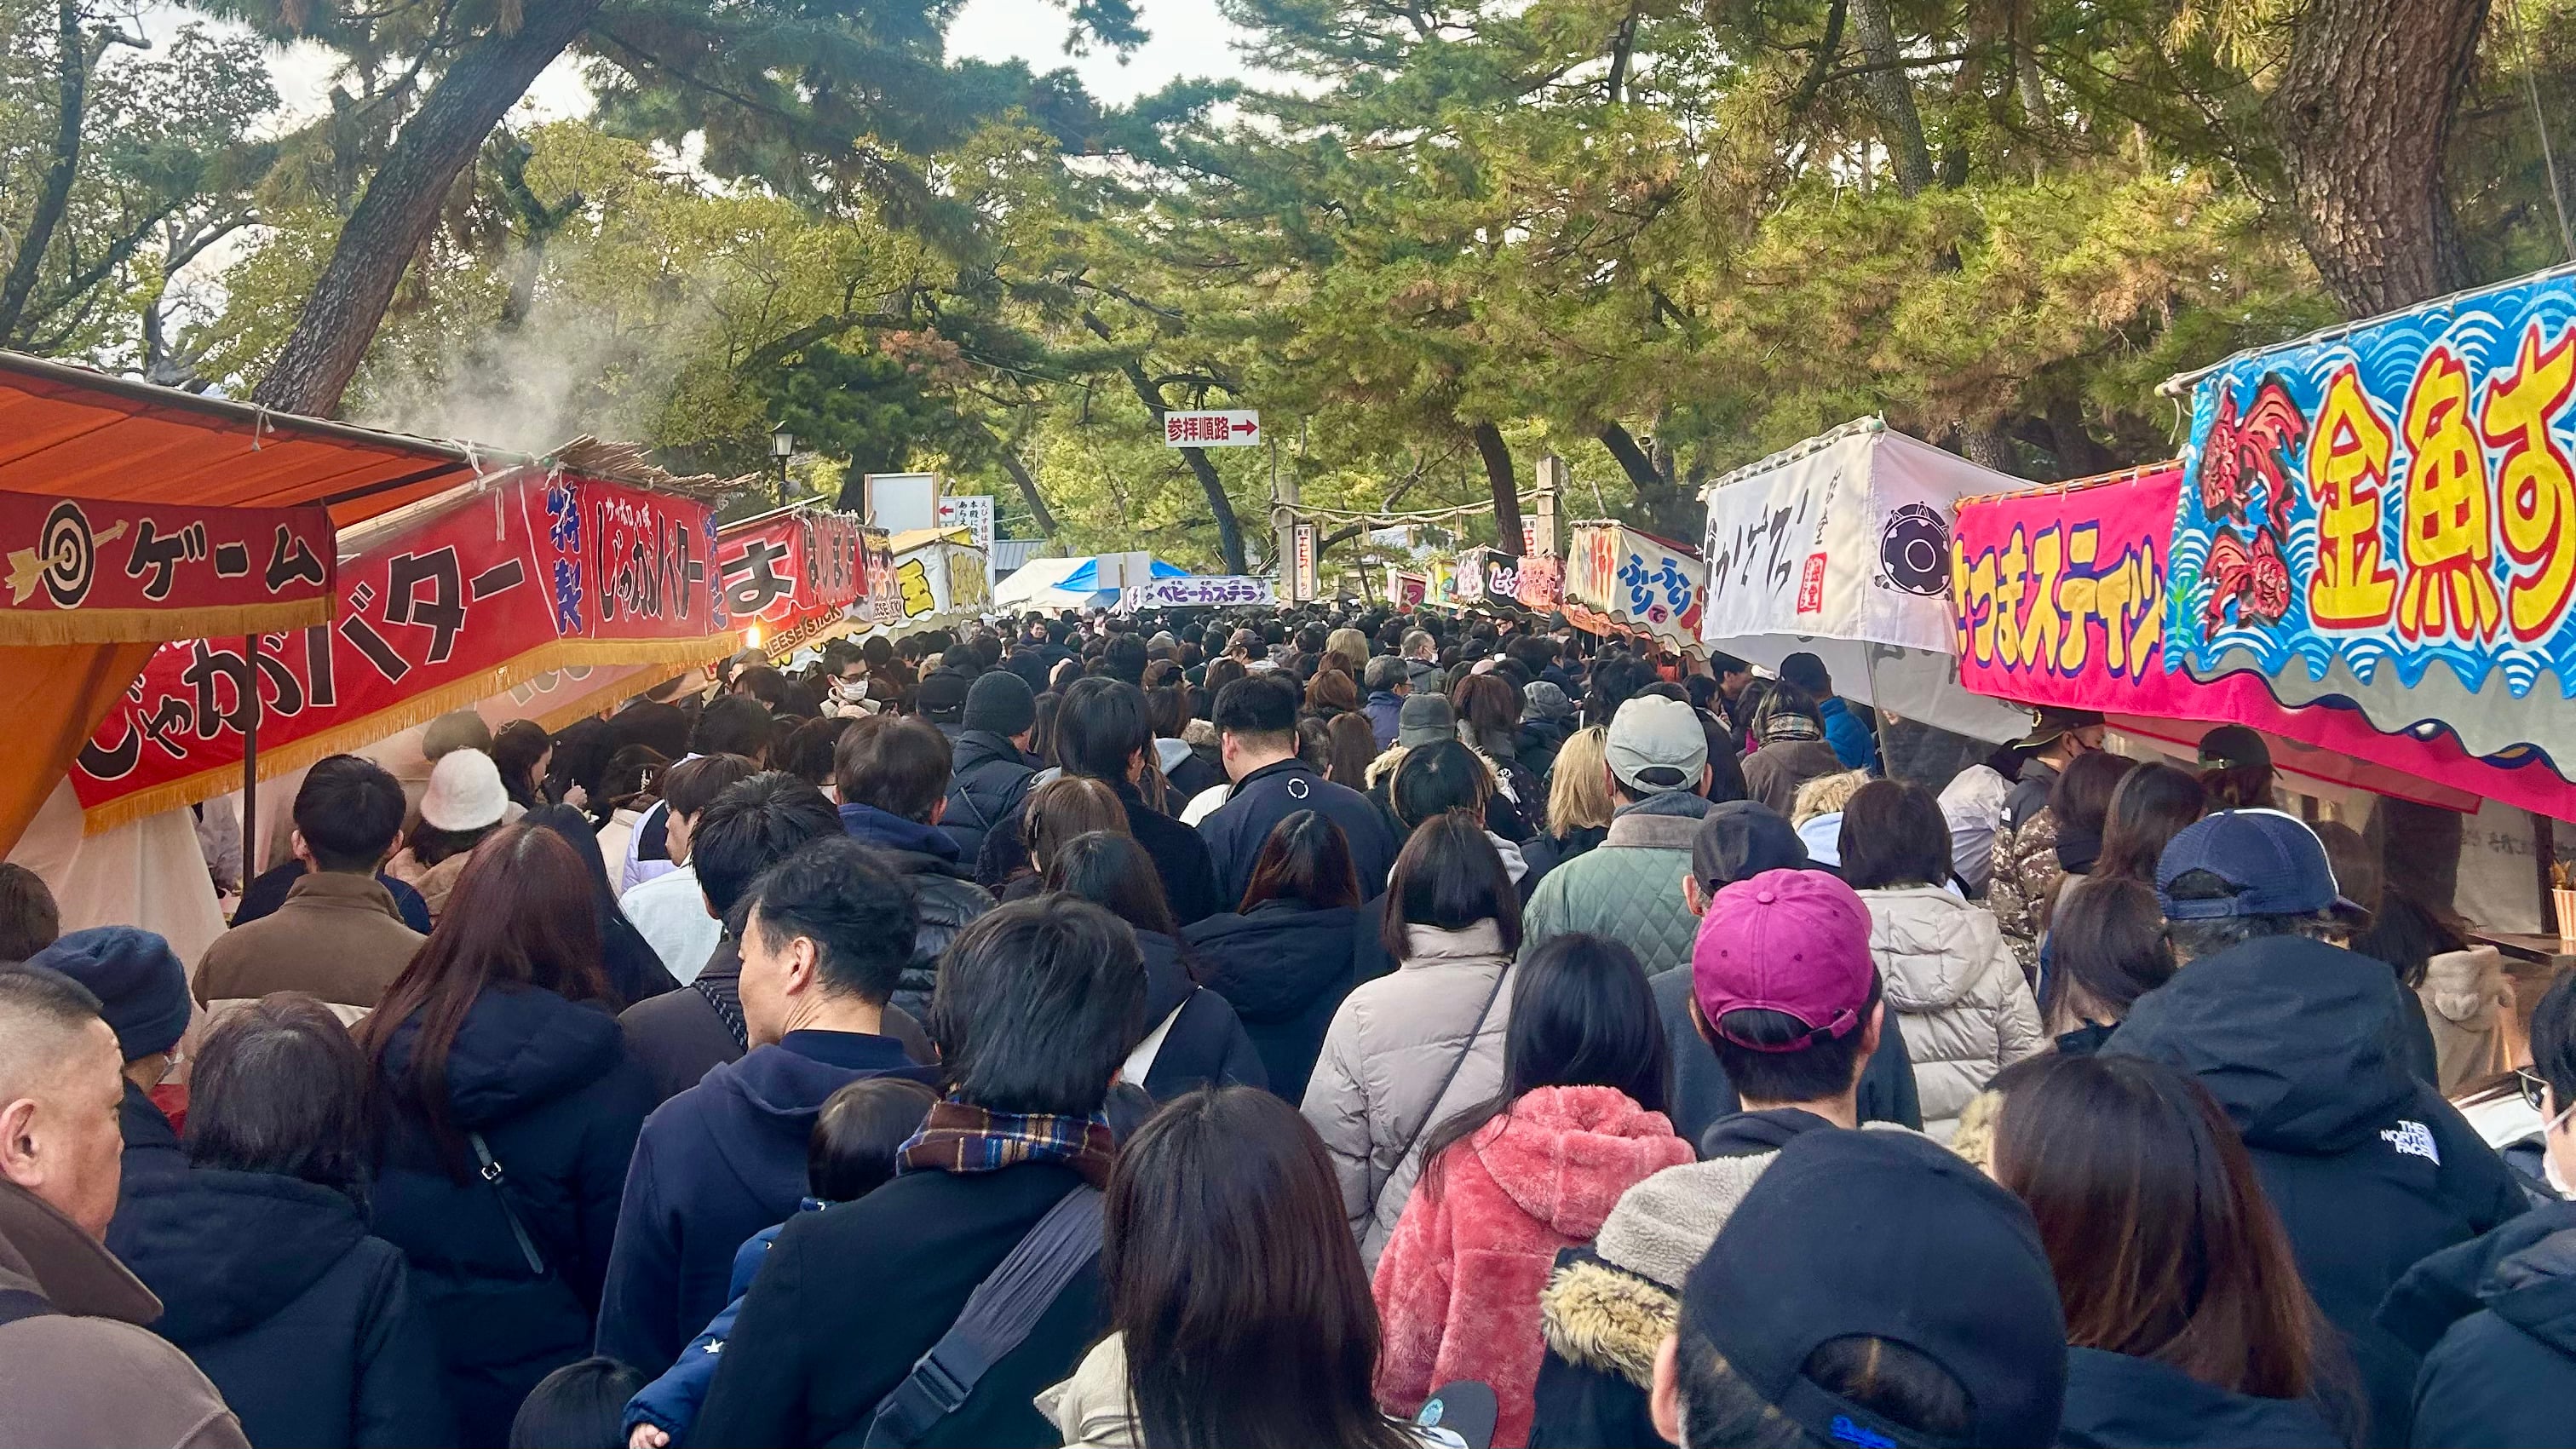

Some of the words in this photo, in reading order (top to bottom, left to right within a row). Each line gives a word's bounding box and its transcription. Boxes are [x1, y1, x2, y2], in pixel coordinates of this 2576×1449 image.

[1168, 417, 1229, 441] 参拝順路
[127, 517, 325, 601] ゲーム
[546, 480, 584, 636] 特製
[596, 500, 704, 623] じゃがバター
[1157, 585, 1257, 602] ベビーカステラ
[75, 544, 526, 781] じゃがバター
